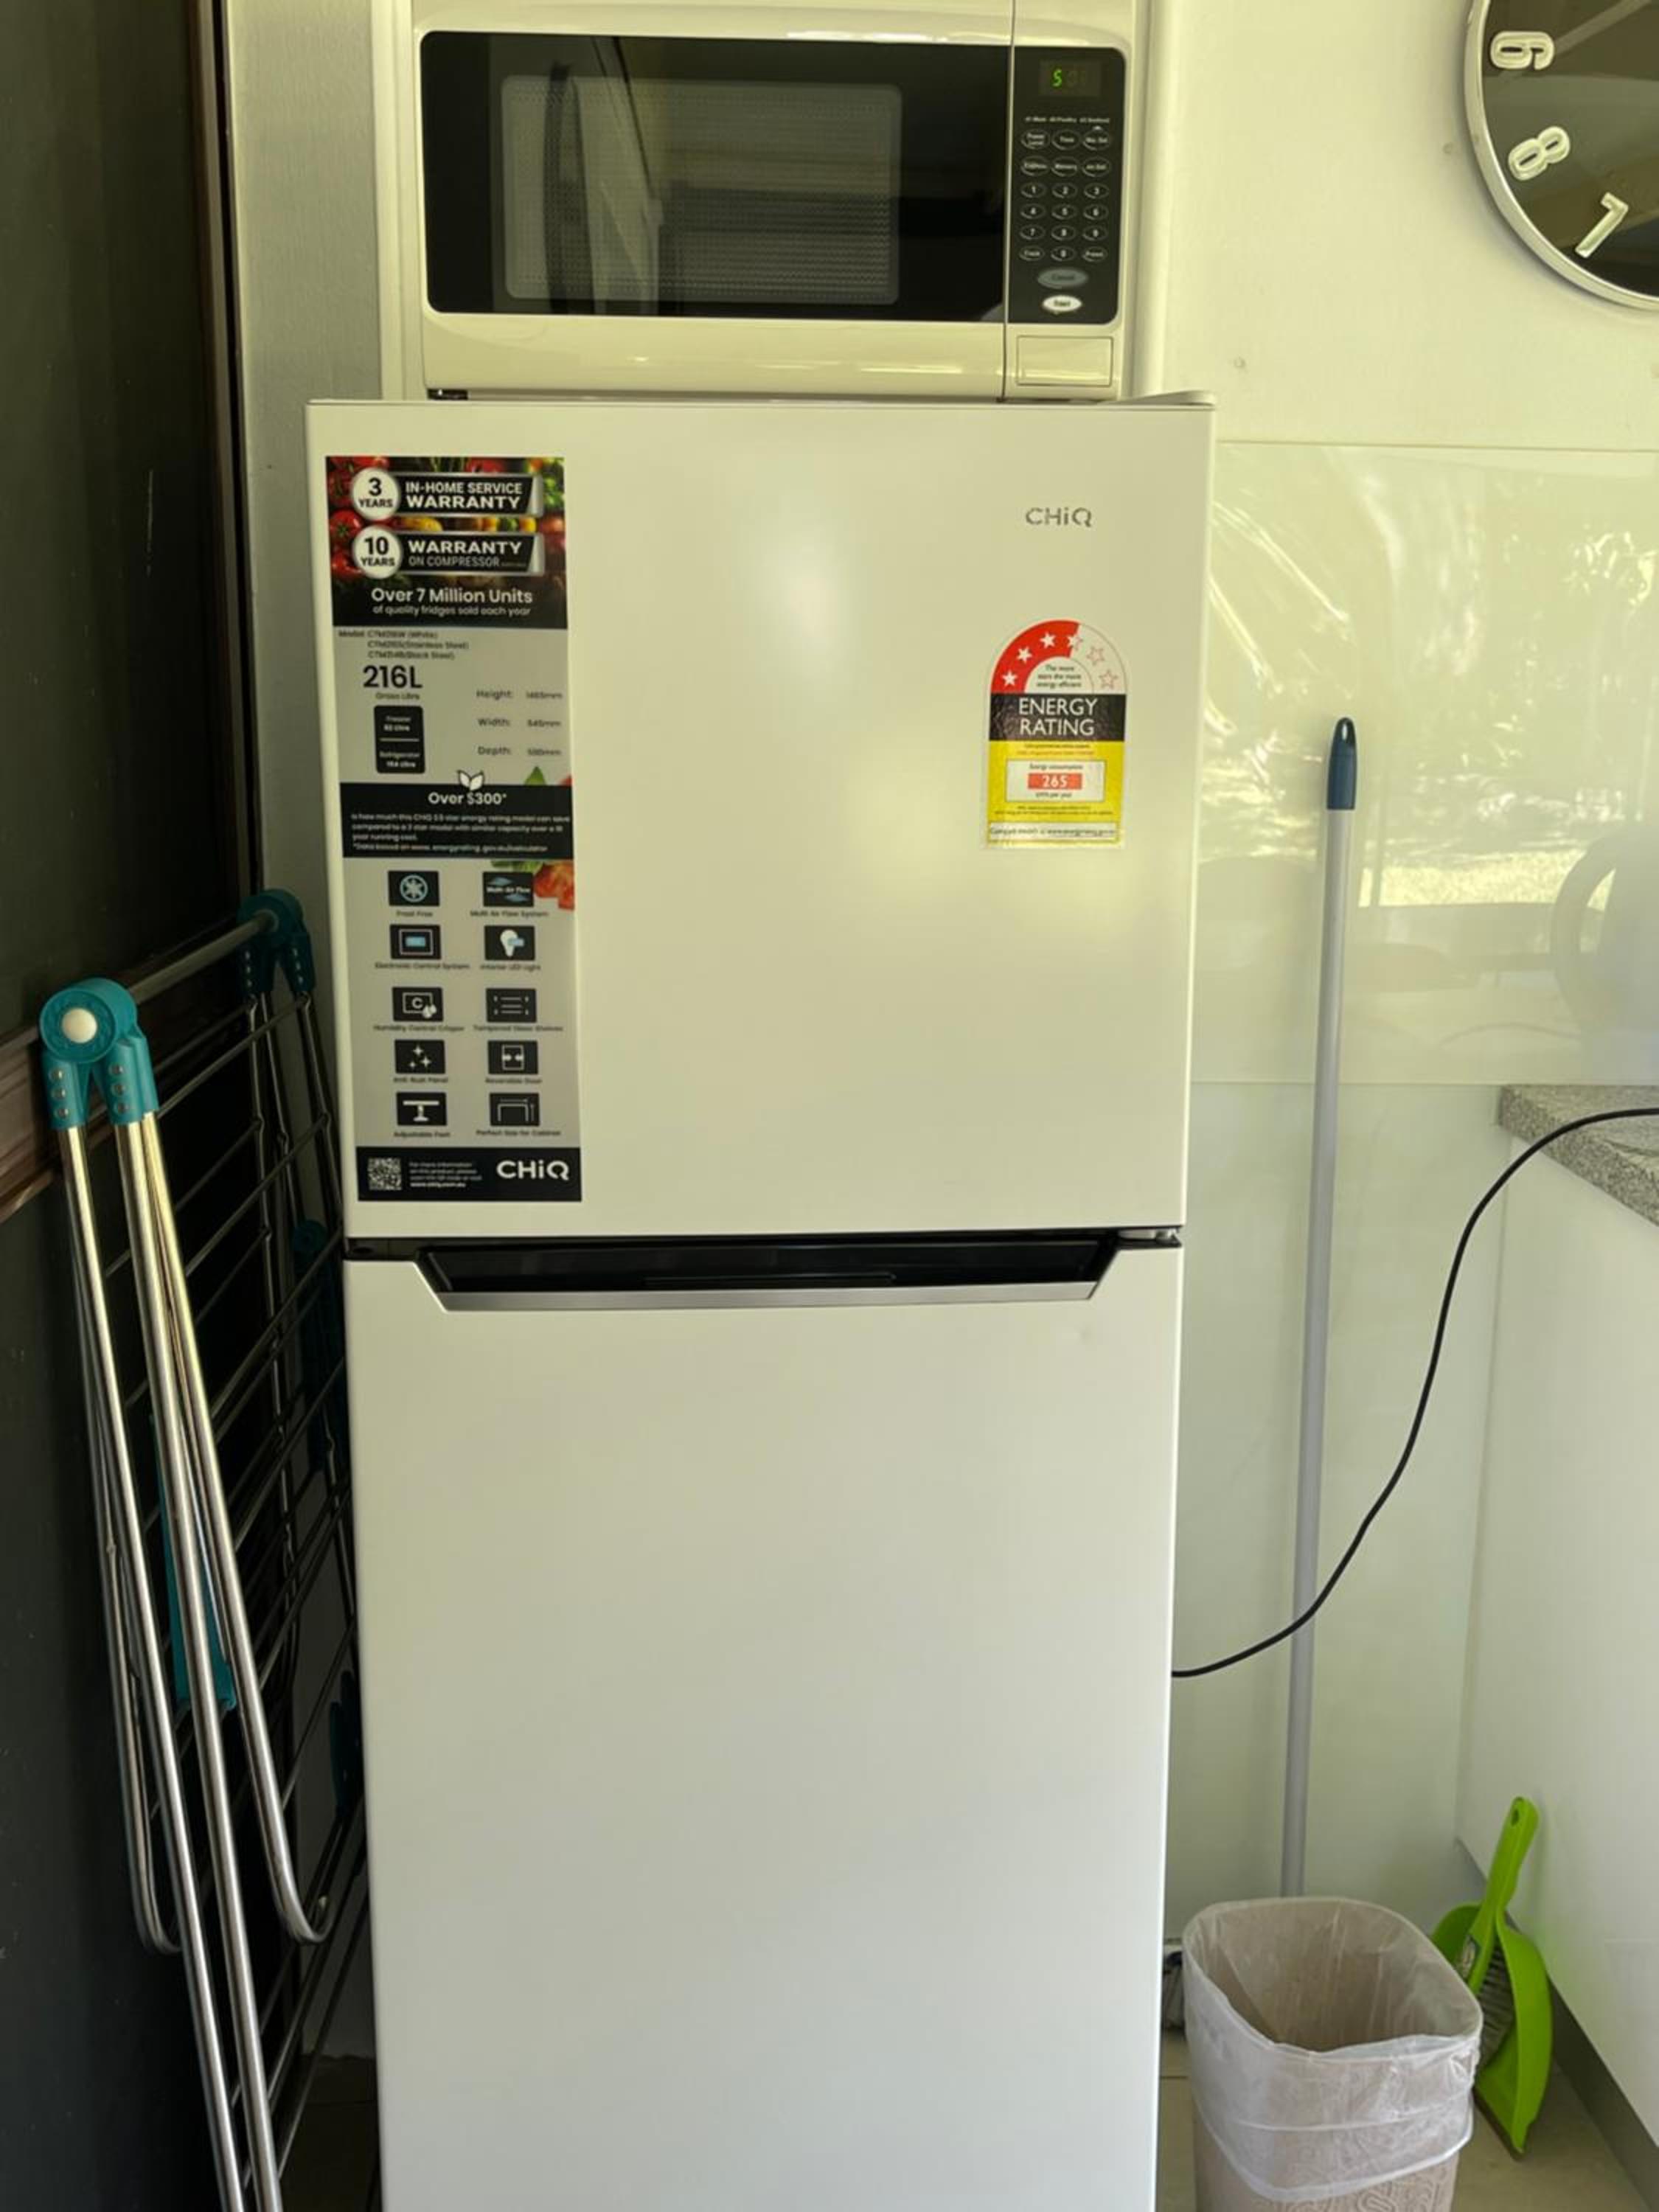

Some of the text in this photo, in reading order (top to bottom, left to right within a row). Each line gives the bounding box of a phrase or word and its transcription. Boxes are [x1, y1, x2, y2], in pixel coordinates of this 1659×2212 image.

[1490, 31, 1554, 70] 9
[1509, 126, 1571, 181] 8
[369, 478, 382, 495] 3
[406, 481, 522, 495] IN-HOME SERVICE
[359, 498, 393, 508] YEARS
[406, 495, 520, 509] WARRANTY
[1026, 507, 1091, 527] CHiQ
[364, 537, 389, 554] 10
[408, 540, 522, 554] WARRANTY
[360, 557, 395, 566] YEARS
[408, 556, 426, 566] ON
[429, 556, 500, 567] COMPRESSOR
[371, 588, 533, 603] Over 7 Million Units
[372, 605, 531, 617] of quality fridges sold each year
[363, 665, 422, 689] 216L
[1018, 698, 1098, 717] ENERGY
[1019, 719, 1095, 736] RATING
[1042, 775, 1068, 788] 265
[428, 792, 464, 804] Over
[411, 997, 423, 1009] C
[496, 1160, 570, 1181] CHiQ
